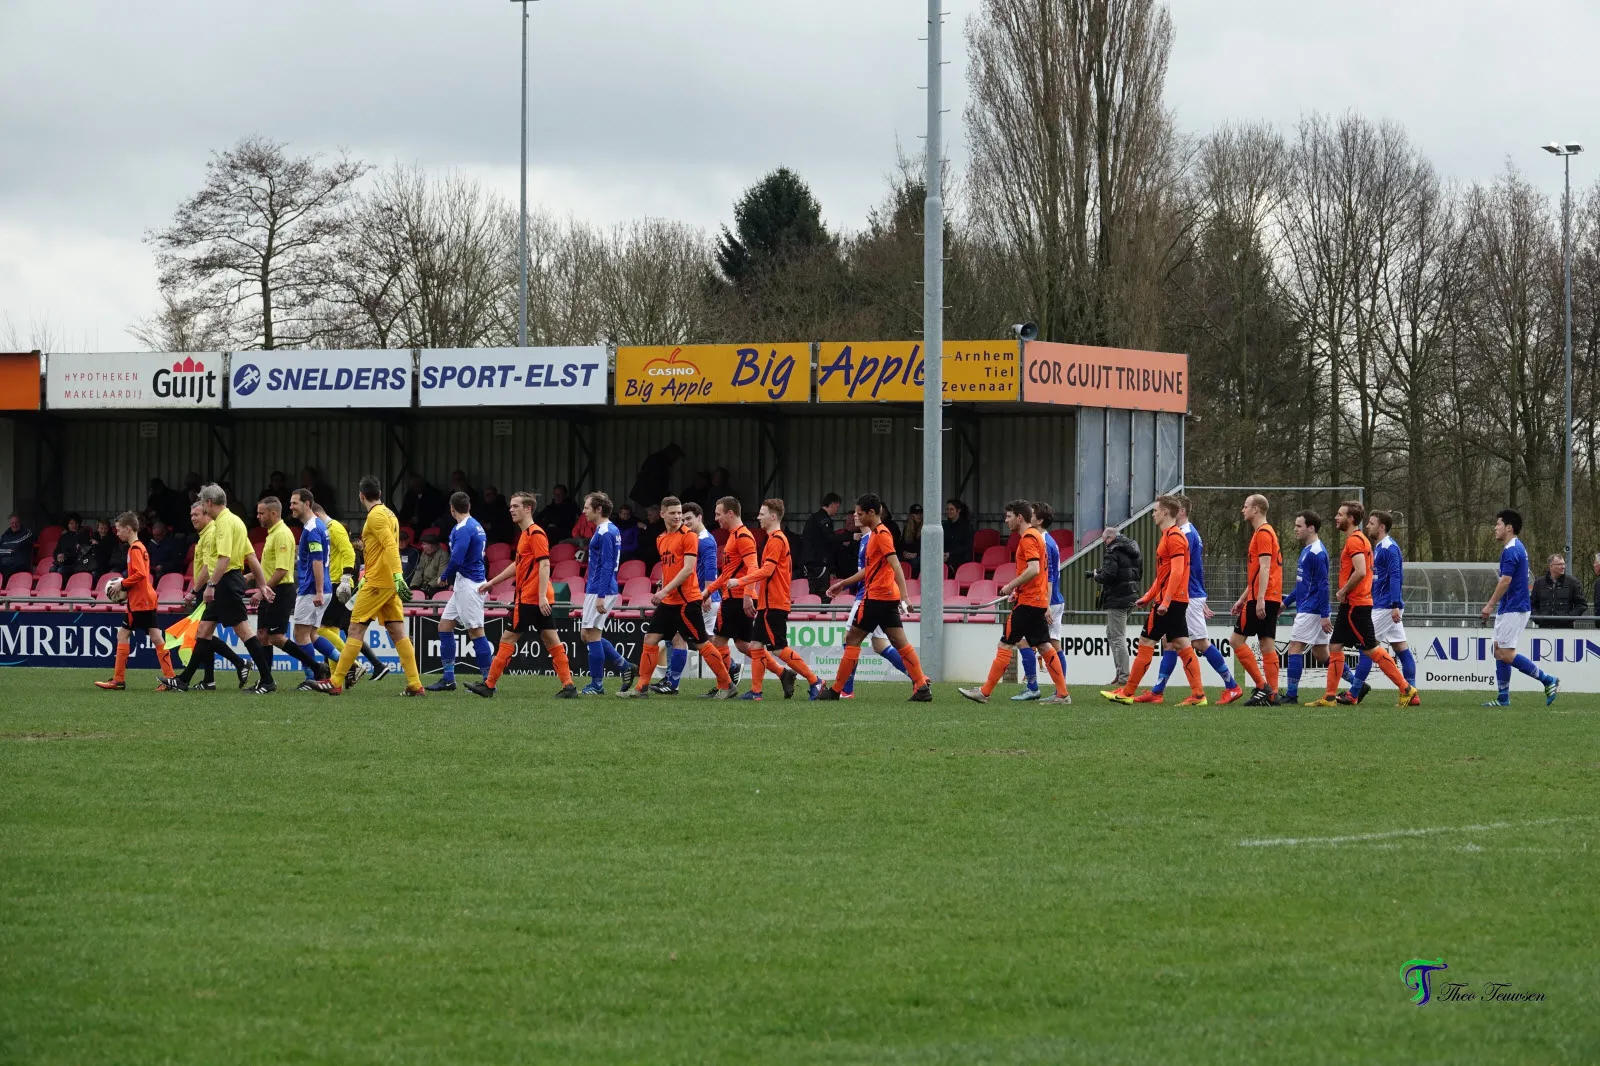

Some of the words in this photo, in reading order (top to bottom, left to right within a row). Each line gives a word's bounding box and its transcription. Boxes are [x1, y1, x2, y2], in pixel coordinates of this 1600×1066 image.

[954, 350, 1014, 362] Arnhem
[64, 372, 138, 381] HYPOTHEKEN
[266, 367, 407, 391] SNELDERS
[421, 363, 599, 389] SPORT-ELST
[648, 367, 694, 376] CASINO
[731, 348, 796, 400] Big
[818, 344, 924, 398] Apple
[985, 366, 1014, 377] Tiel
[1029, 359, 1062, 385] COR
[1067, 363, 1112, 390] GUIJT
[1115, 366, 1183, 394] TRIBUNE
[152, 368, 216, 404] Guijt
[625, 379, 654, 402] Big
[661, 377, 713, 402] Apple
[942, 381, 1014, 392] Zevenaar
[64, 389, 142, 399] MAKELAARDIJ
[602, 619, 635, 633] Miko
[1424, 636, 1494, 661] AUT
[1426, 671, 1495, 686] Doornenburg
